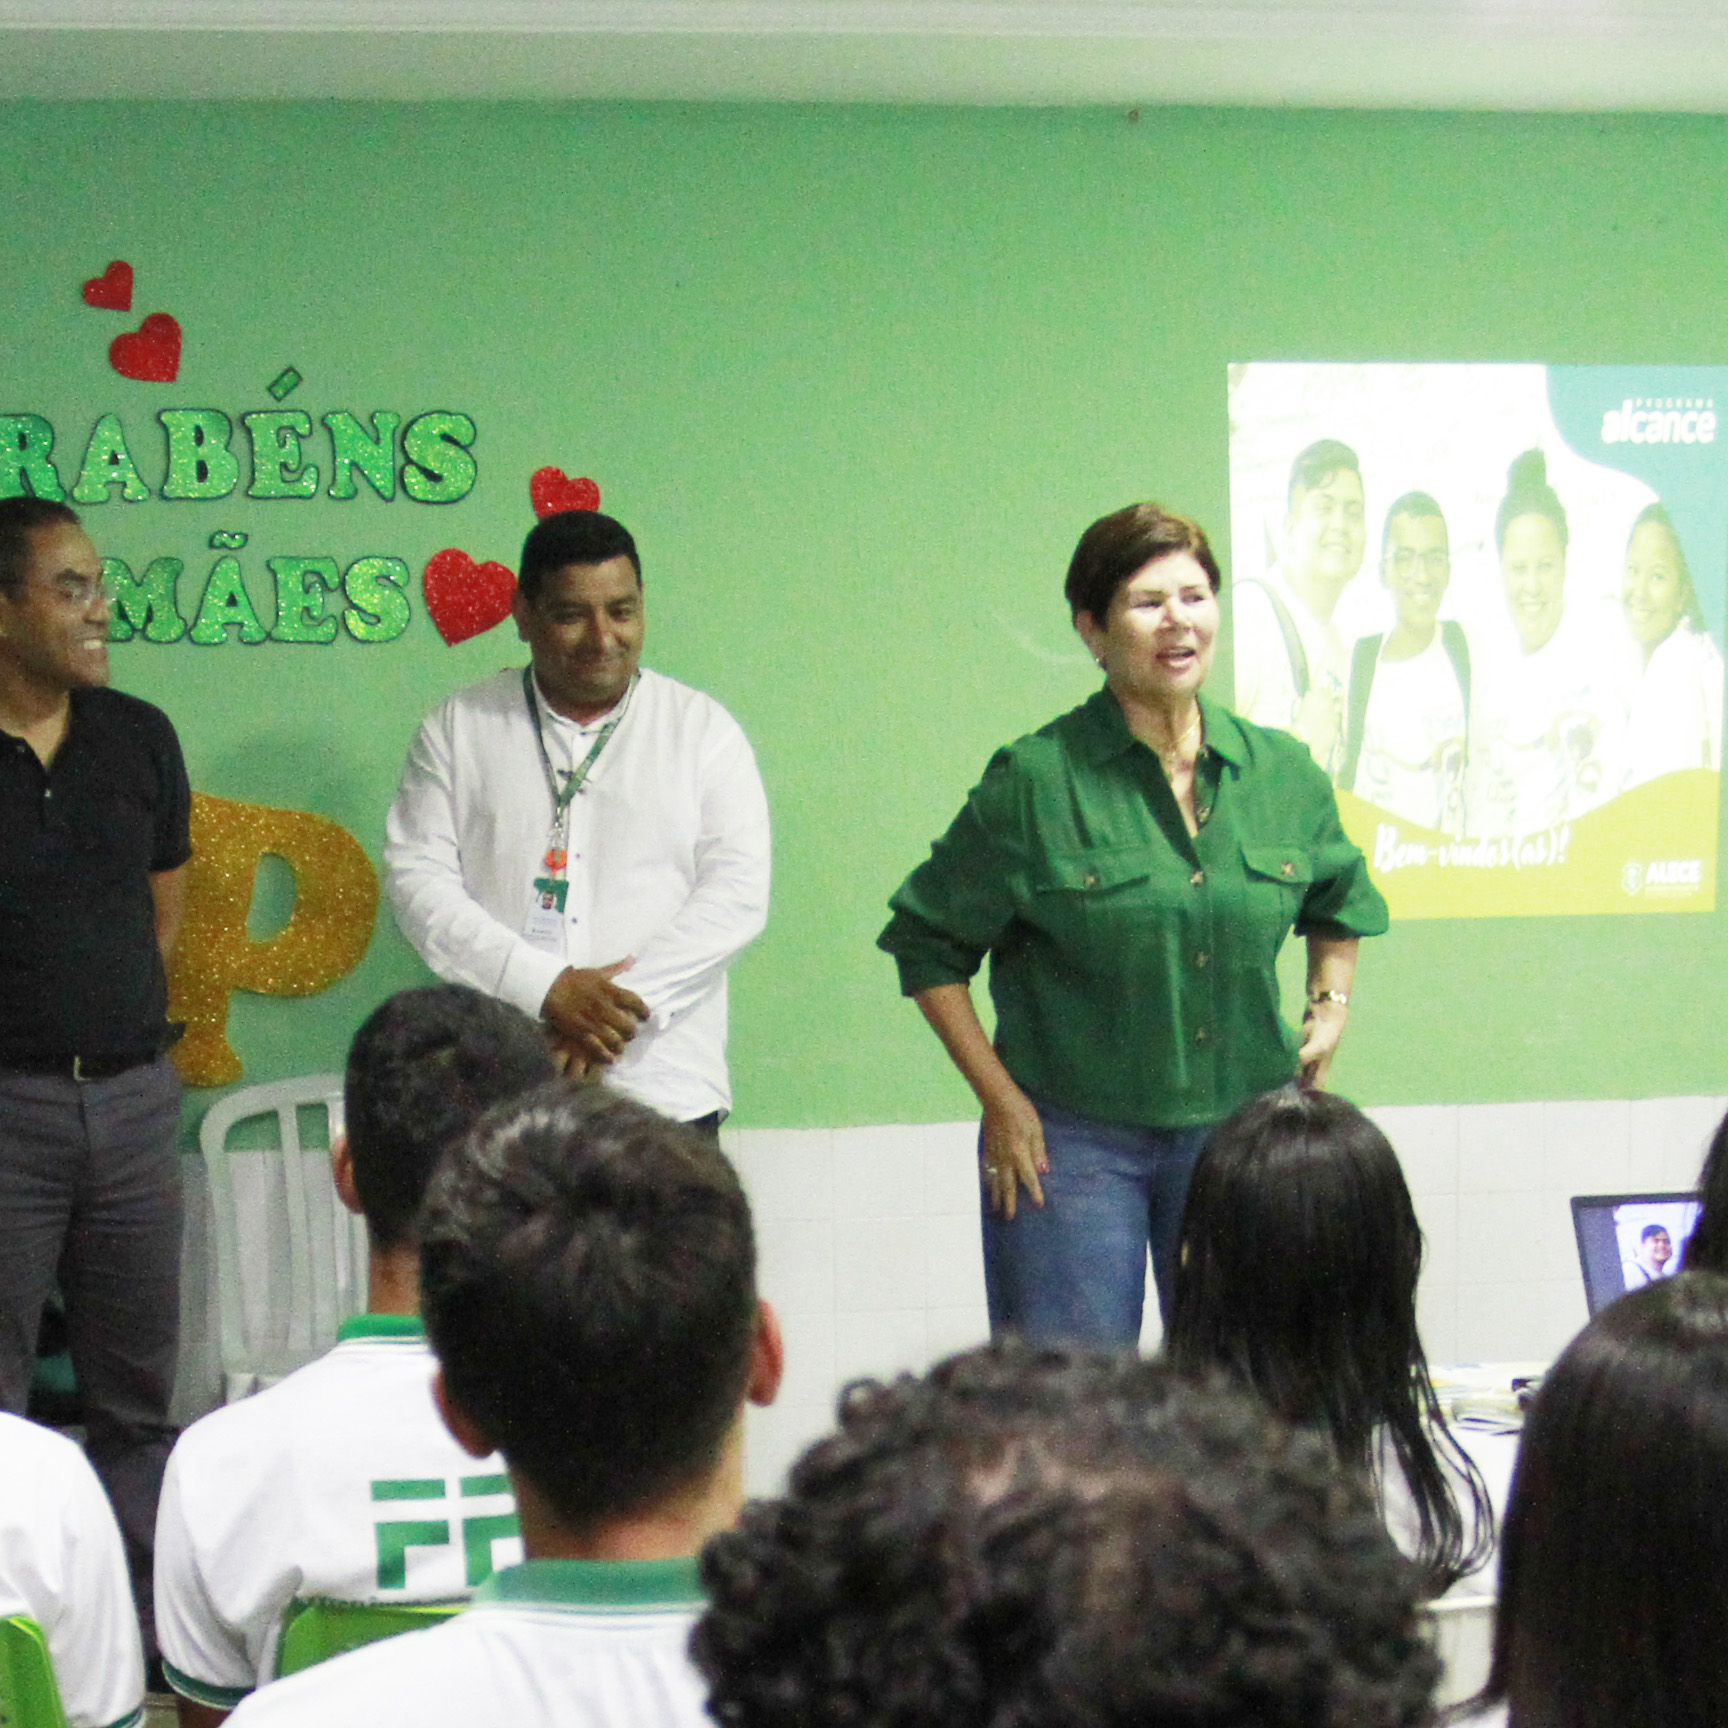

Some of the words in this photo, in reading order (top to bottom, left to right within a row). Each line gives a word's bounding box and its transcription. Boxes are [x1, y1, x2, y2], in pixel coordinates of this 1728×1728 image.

[1601, 399, 1717, 444] alcance
[1373, 822, 1571, 873] Bem-vindos(as)!
[1645, 859, 1702, 885] ALECE
[164, 791, 380, 1089] P
